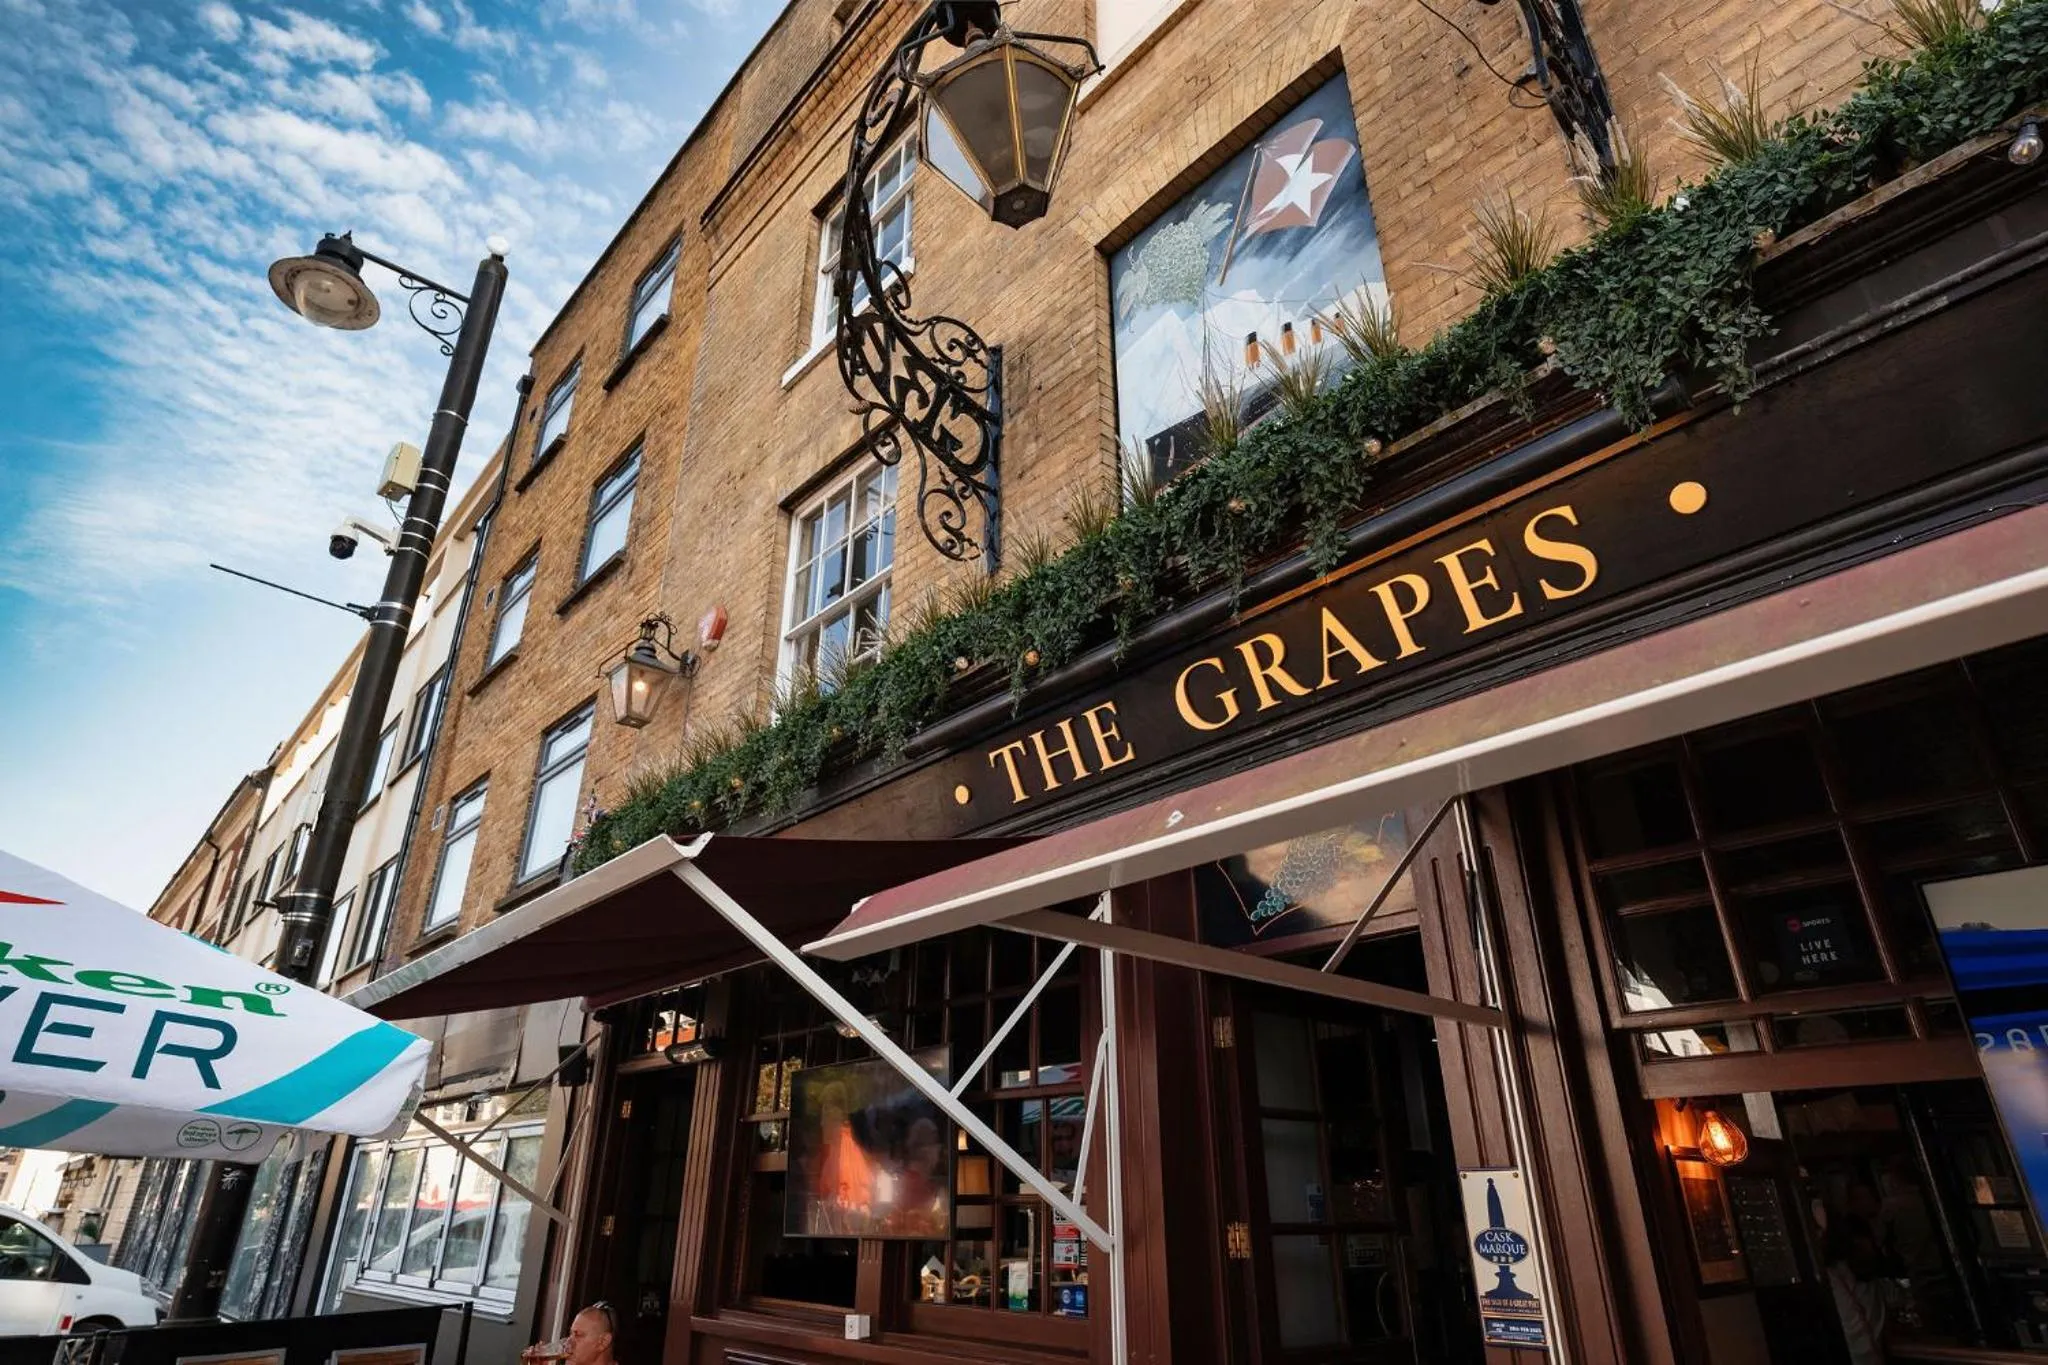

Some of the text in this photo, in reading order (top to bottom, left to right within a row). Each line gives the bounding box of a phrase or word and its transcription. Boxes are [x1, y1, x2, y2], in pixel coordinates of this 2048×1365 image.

[988, 504, 1598, 804] THE GRAPES
[1800, 938, 1831, 952] LIVE
[1801, 950, 1838, 965] HERE
[0, 985, 238, 1090] ER
[1484, 1230, 1514, 1243] CASK
[1479, 1242, 1526, 1255] MARQUE
